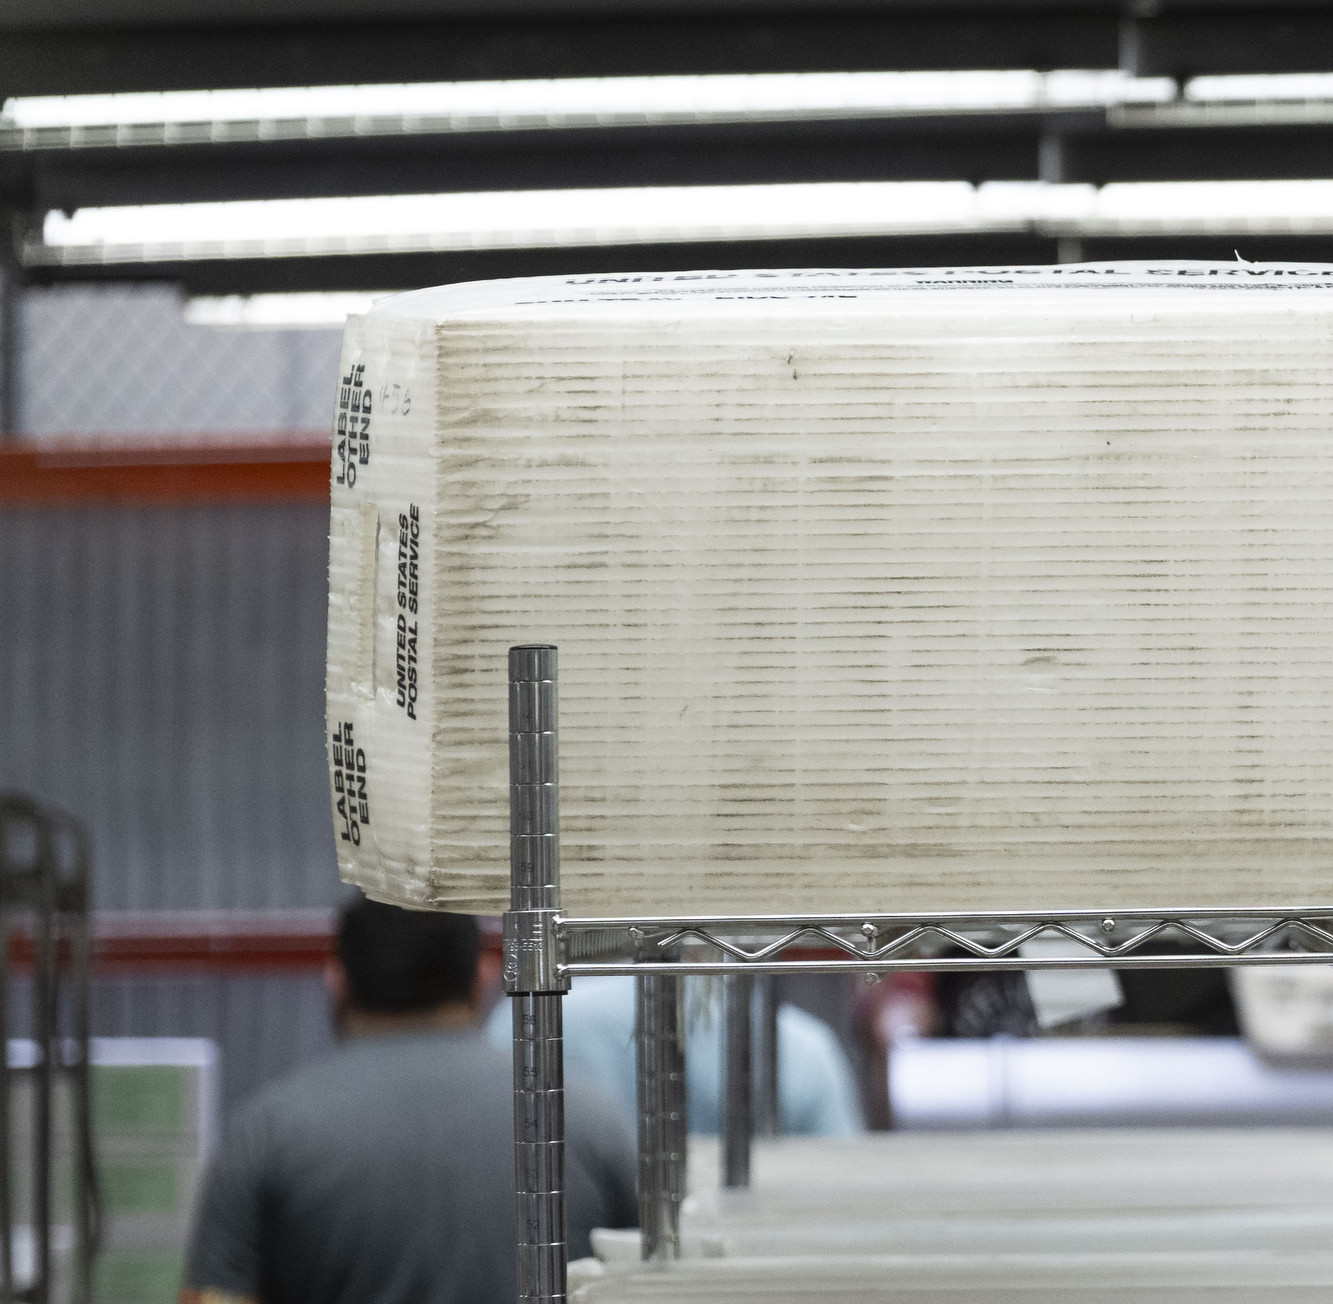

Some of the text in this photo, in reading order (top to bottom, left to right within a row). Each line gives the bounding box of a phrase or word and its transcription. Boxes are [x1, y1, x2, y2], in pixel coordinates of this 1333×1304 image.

[336, 364, 356, 484] LABEL
[347, 364, 366, 488] OTHER
[359, 389, 373, 465] END
[396, 513, 408, 708] UNITED STATES
[407, 503, 420, 720] POSTAL SERVICE
[333, 721, 351, 842] LABEL
[344, 721, 360, 846] OTHER
[356, 748, 370, 825] END
